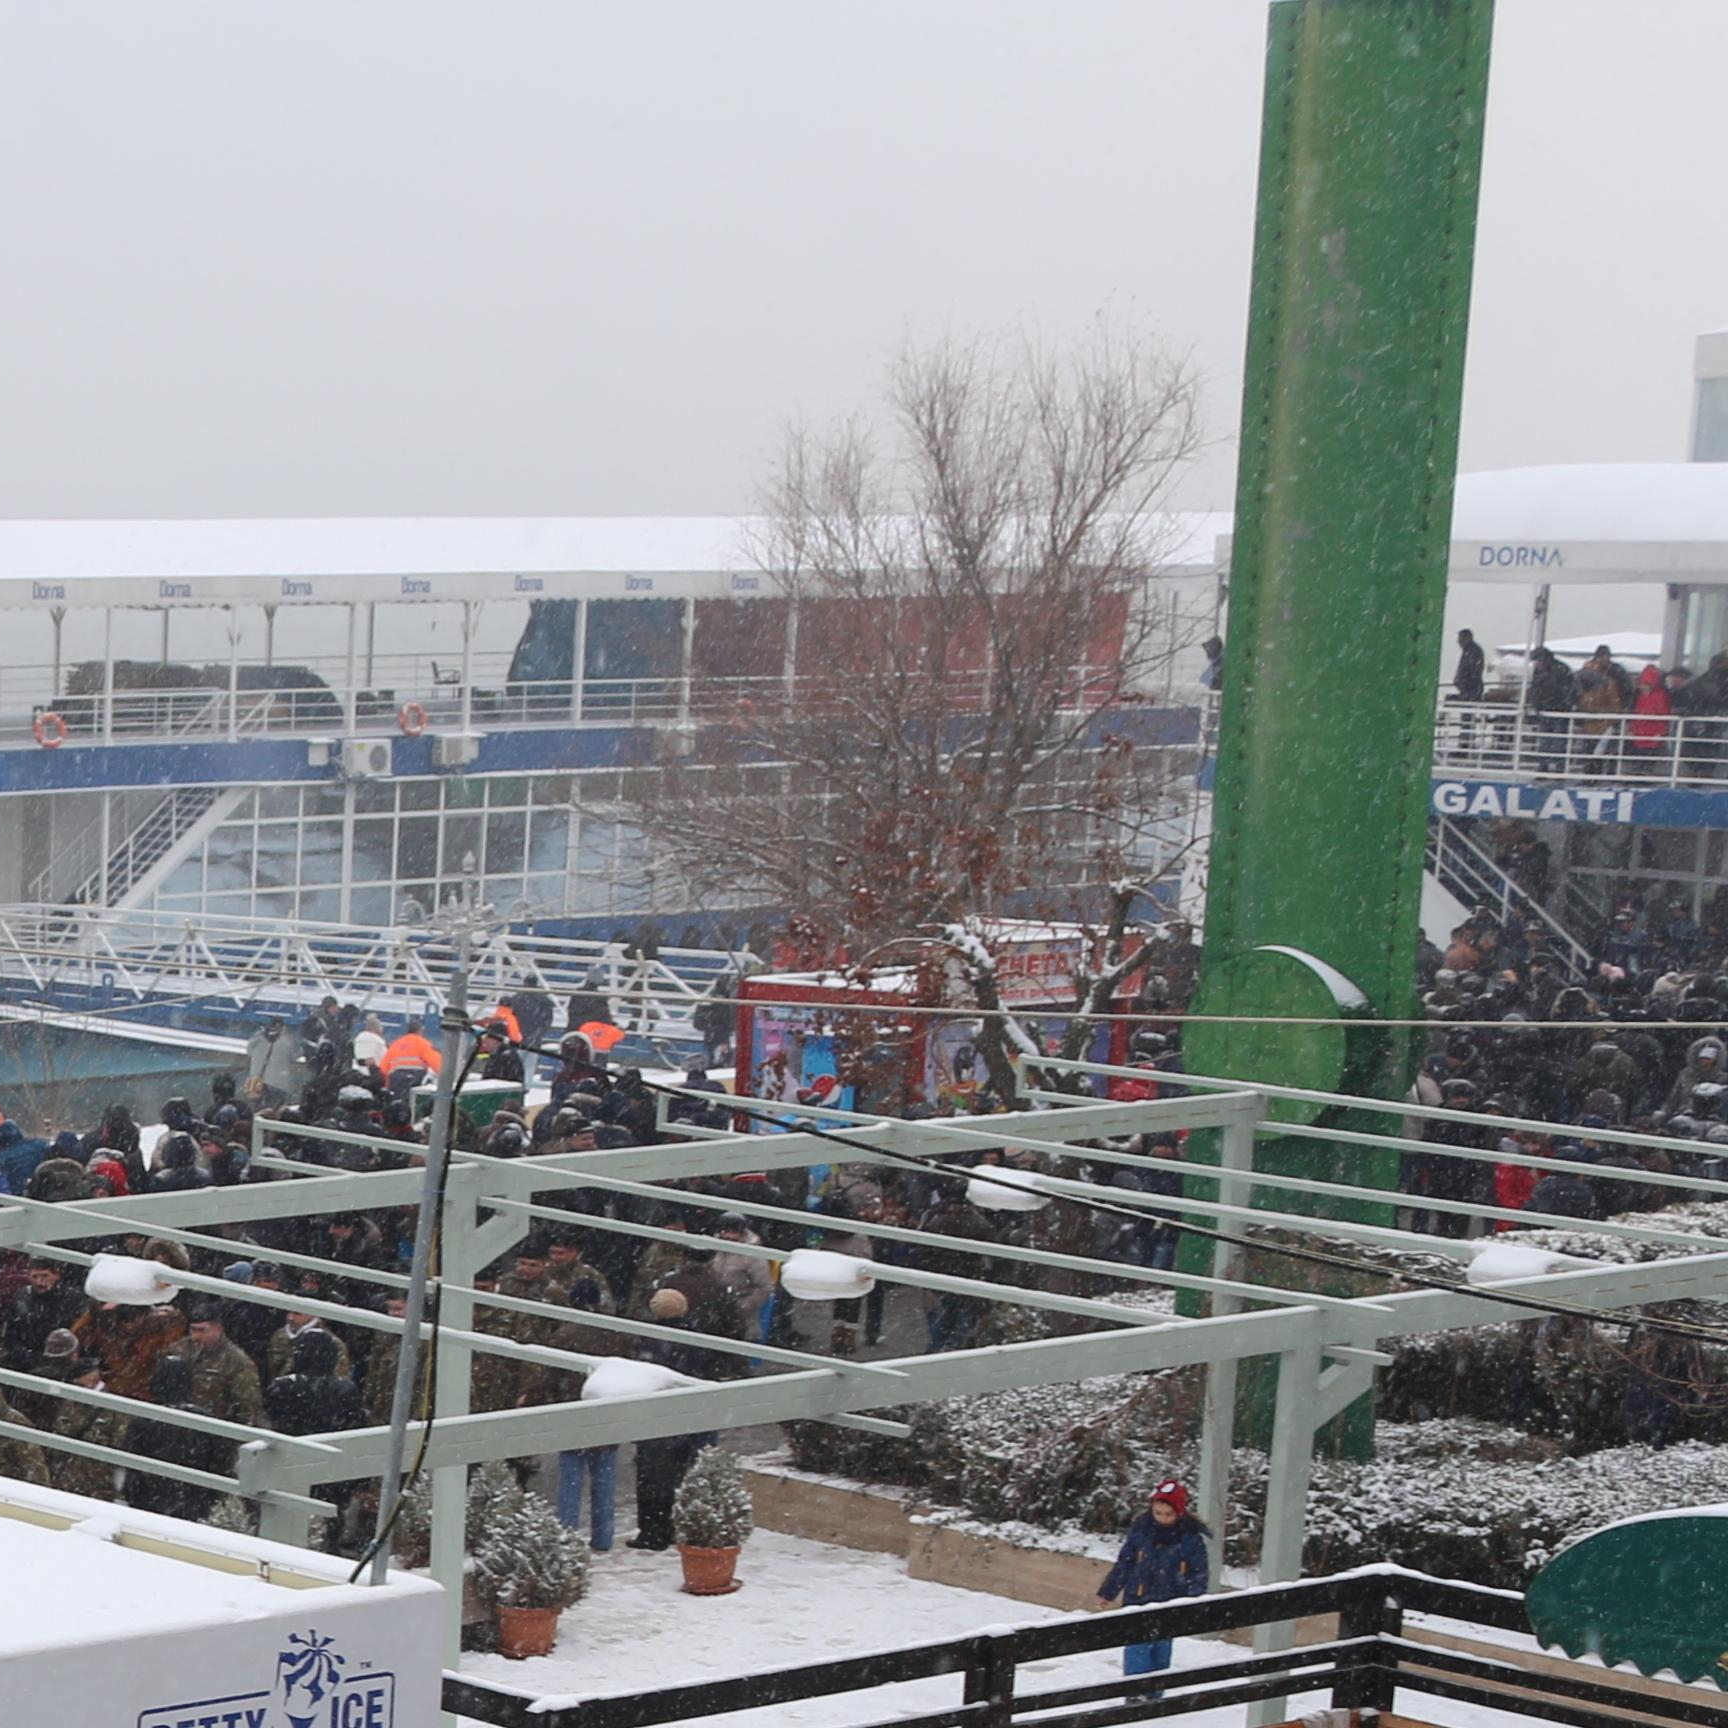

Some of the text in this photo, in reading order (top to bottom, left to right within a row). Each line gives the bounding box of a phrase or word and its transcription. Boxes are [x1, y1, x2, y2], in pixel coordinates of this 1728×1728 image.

[1479, 545, 1563, 568] DORNA
[32, 582, 65, 600] Dorna
[159, 580, 192, 598] Dorna
[281, 578, 313, 596] Dorna
[401, 576, 431, 594] Dorna
[514, 574, 544, 592] Dorna
[625, 574, 653, 591] Dorna
[1432, 782, 1635, 824] GALATI
